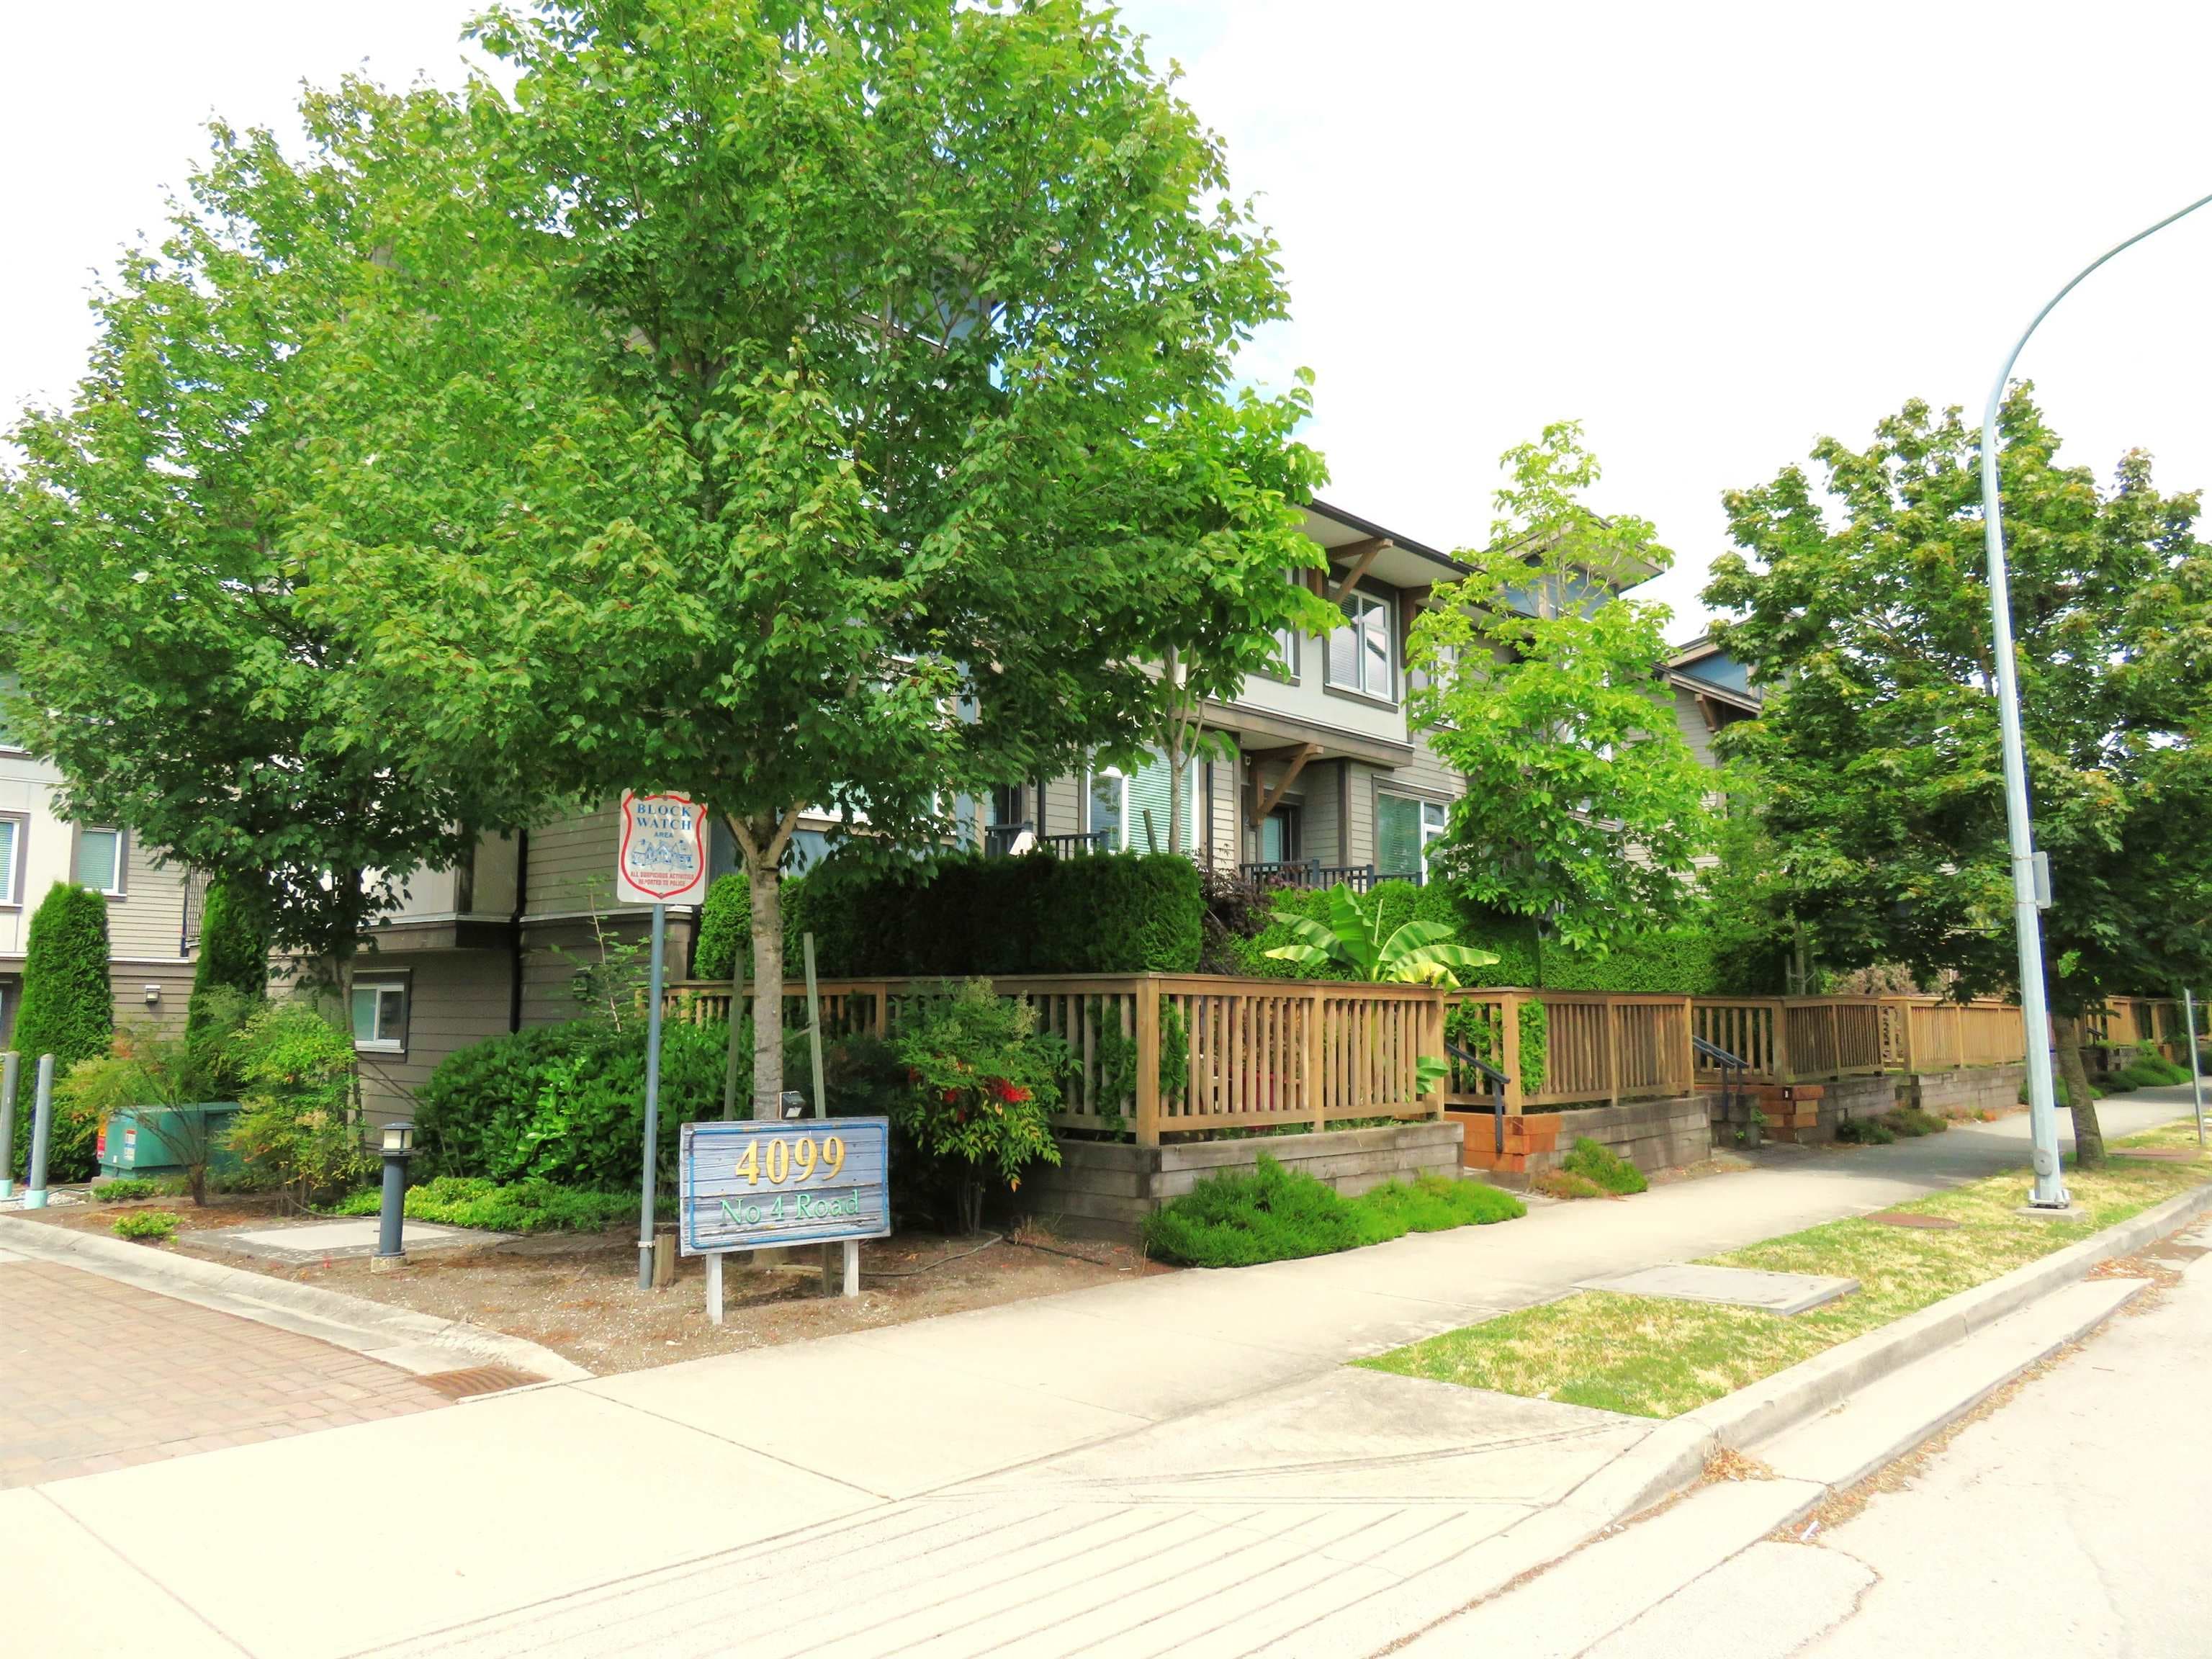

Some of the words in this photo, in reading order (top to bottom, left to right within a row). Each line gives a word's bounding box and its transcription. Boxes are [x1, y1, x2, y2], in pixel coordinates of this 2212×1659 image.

[637, 804, 691, 817] BLOCK
[637, 817, 691, 830] WATCH
[736, 1136, 845, 1185] 4099
[720, 1198, 762, 1224] No
[772, 1195, 785, 1221] 4
[795, 1188, 860, 1220] Road
